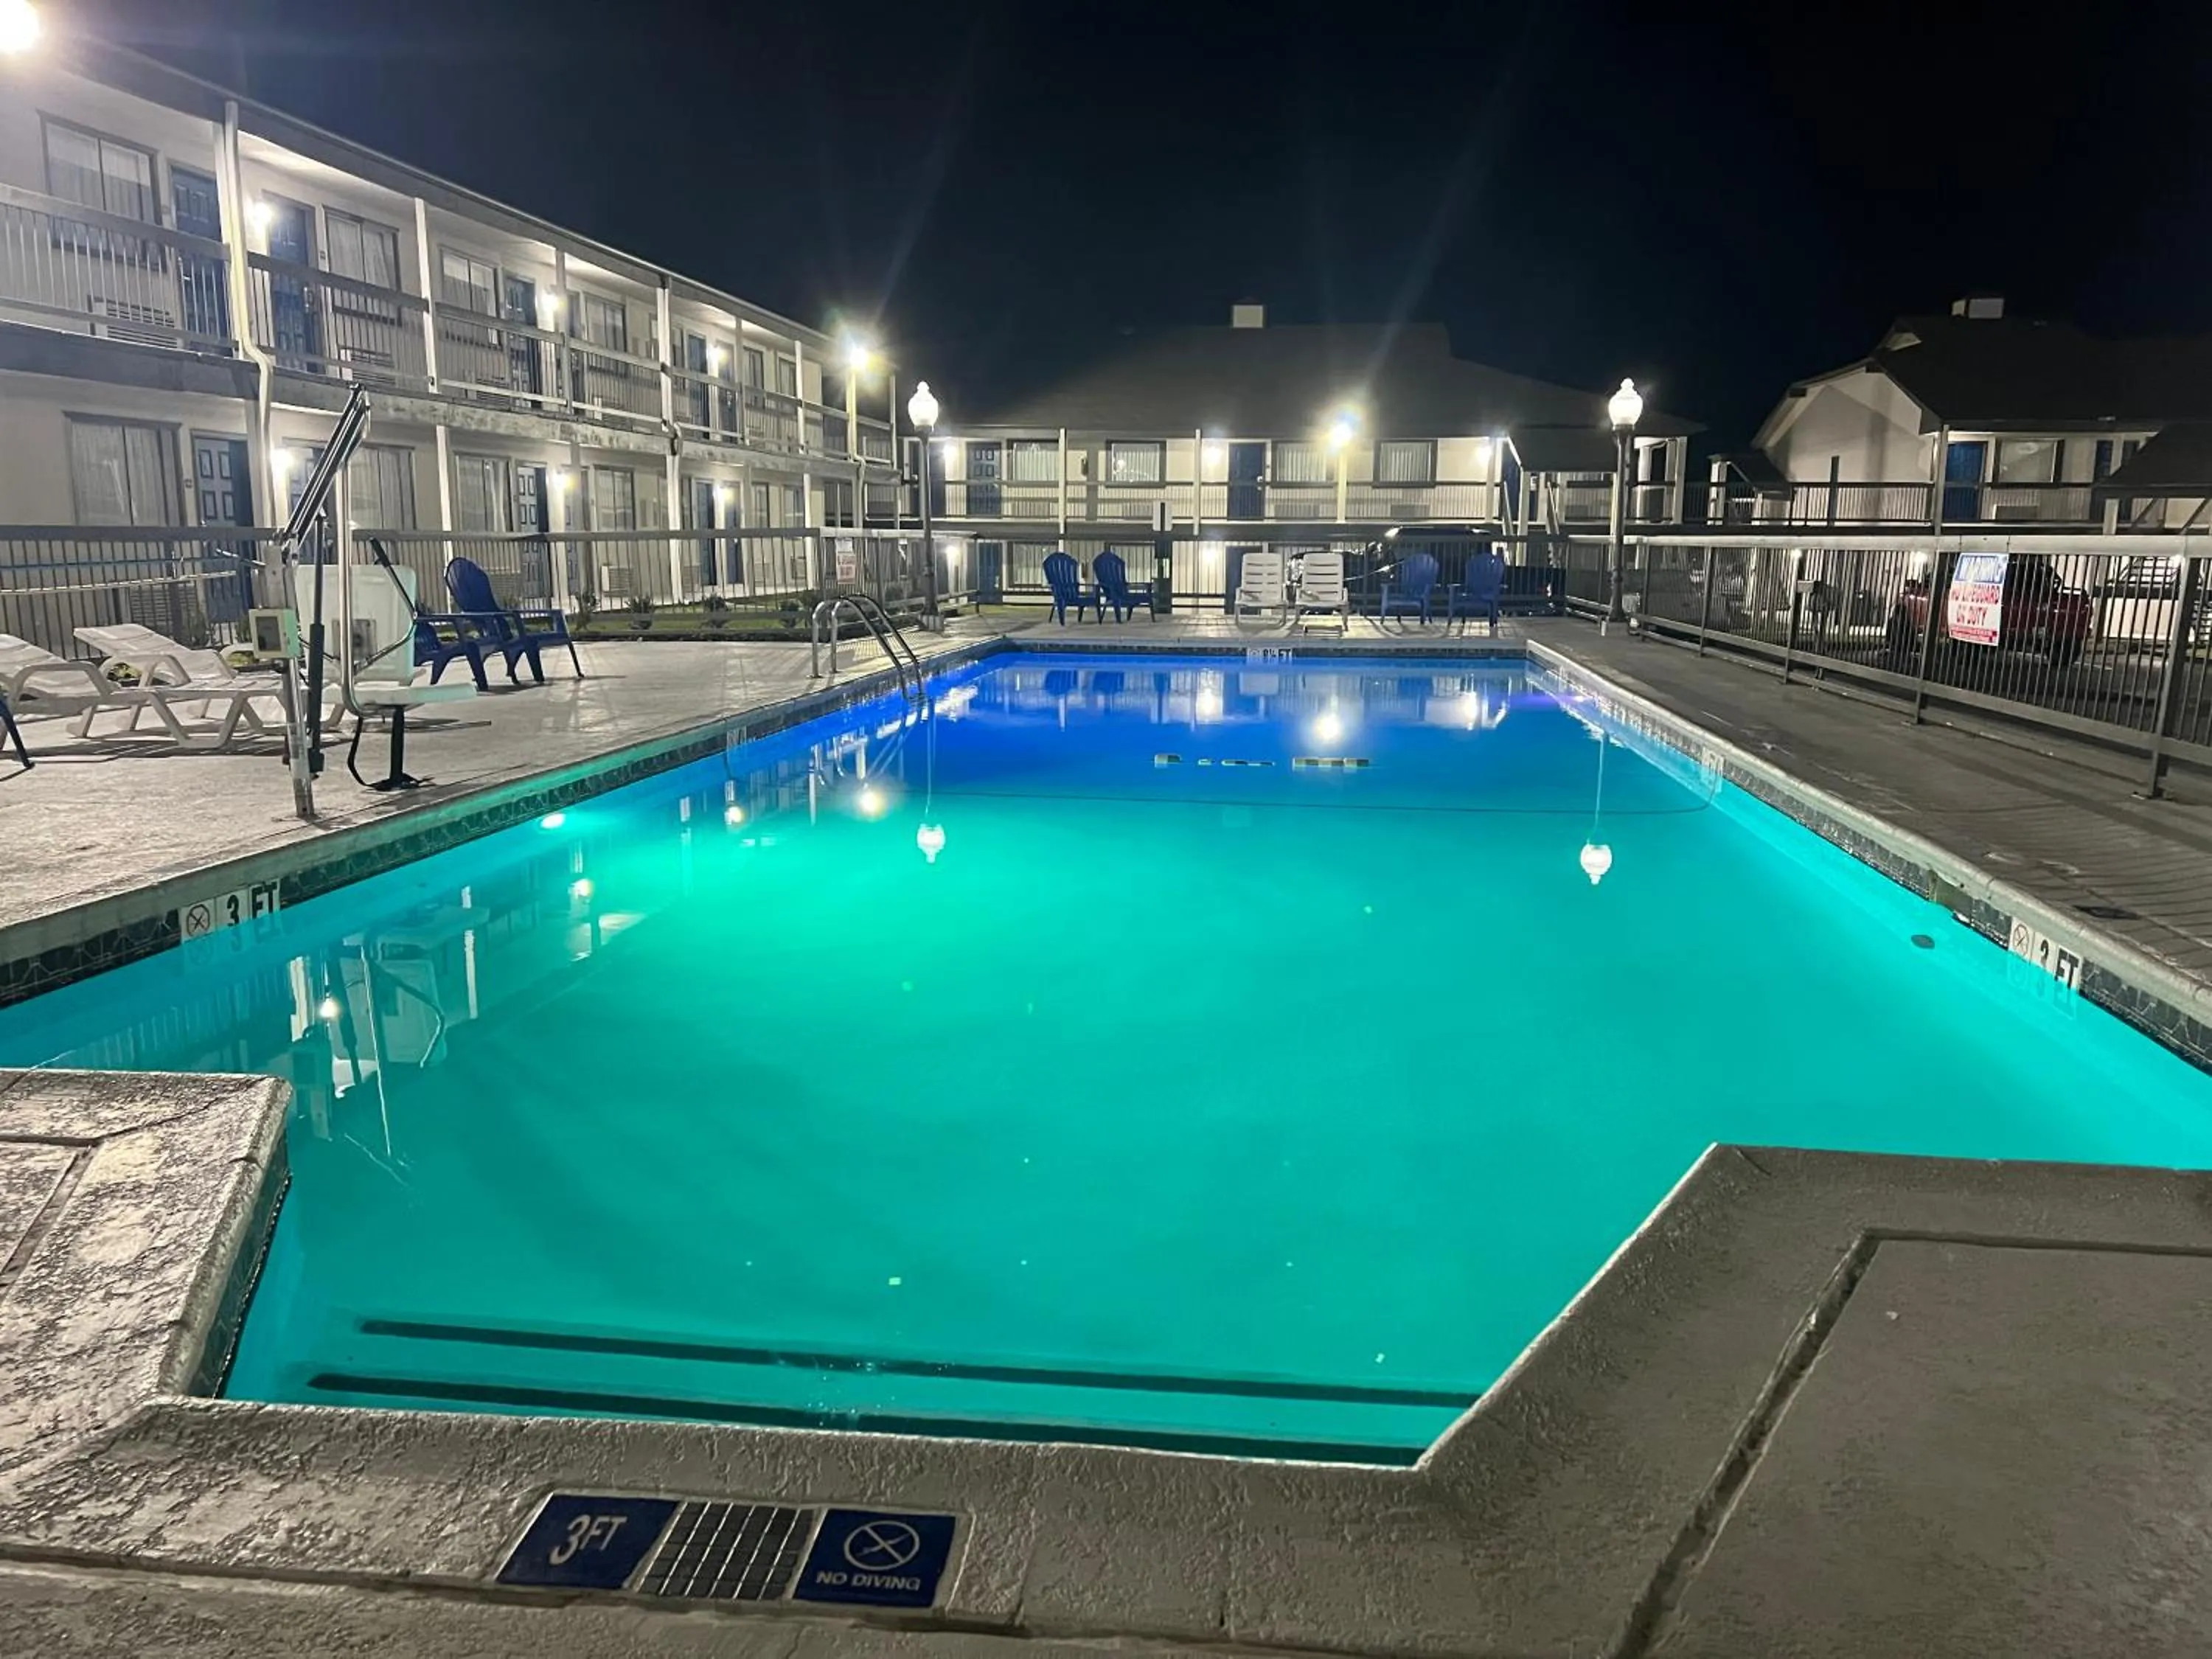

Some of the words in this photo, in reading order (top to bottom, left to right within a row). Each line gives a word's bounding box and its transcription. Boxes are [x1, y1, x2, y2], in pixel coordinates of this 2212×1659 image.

[226, 894, 240, 927] 3
[251, 881, 278, 920] FT
[2054, 947, 2080, 990] FT
[815, 1571, 848, 1587] NO
[852, 1573, 922, 1592] DIVING
